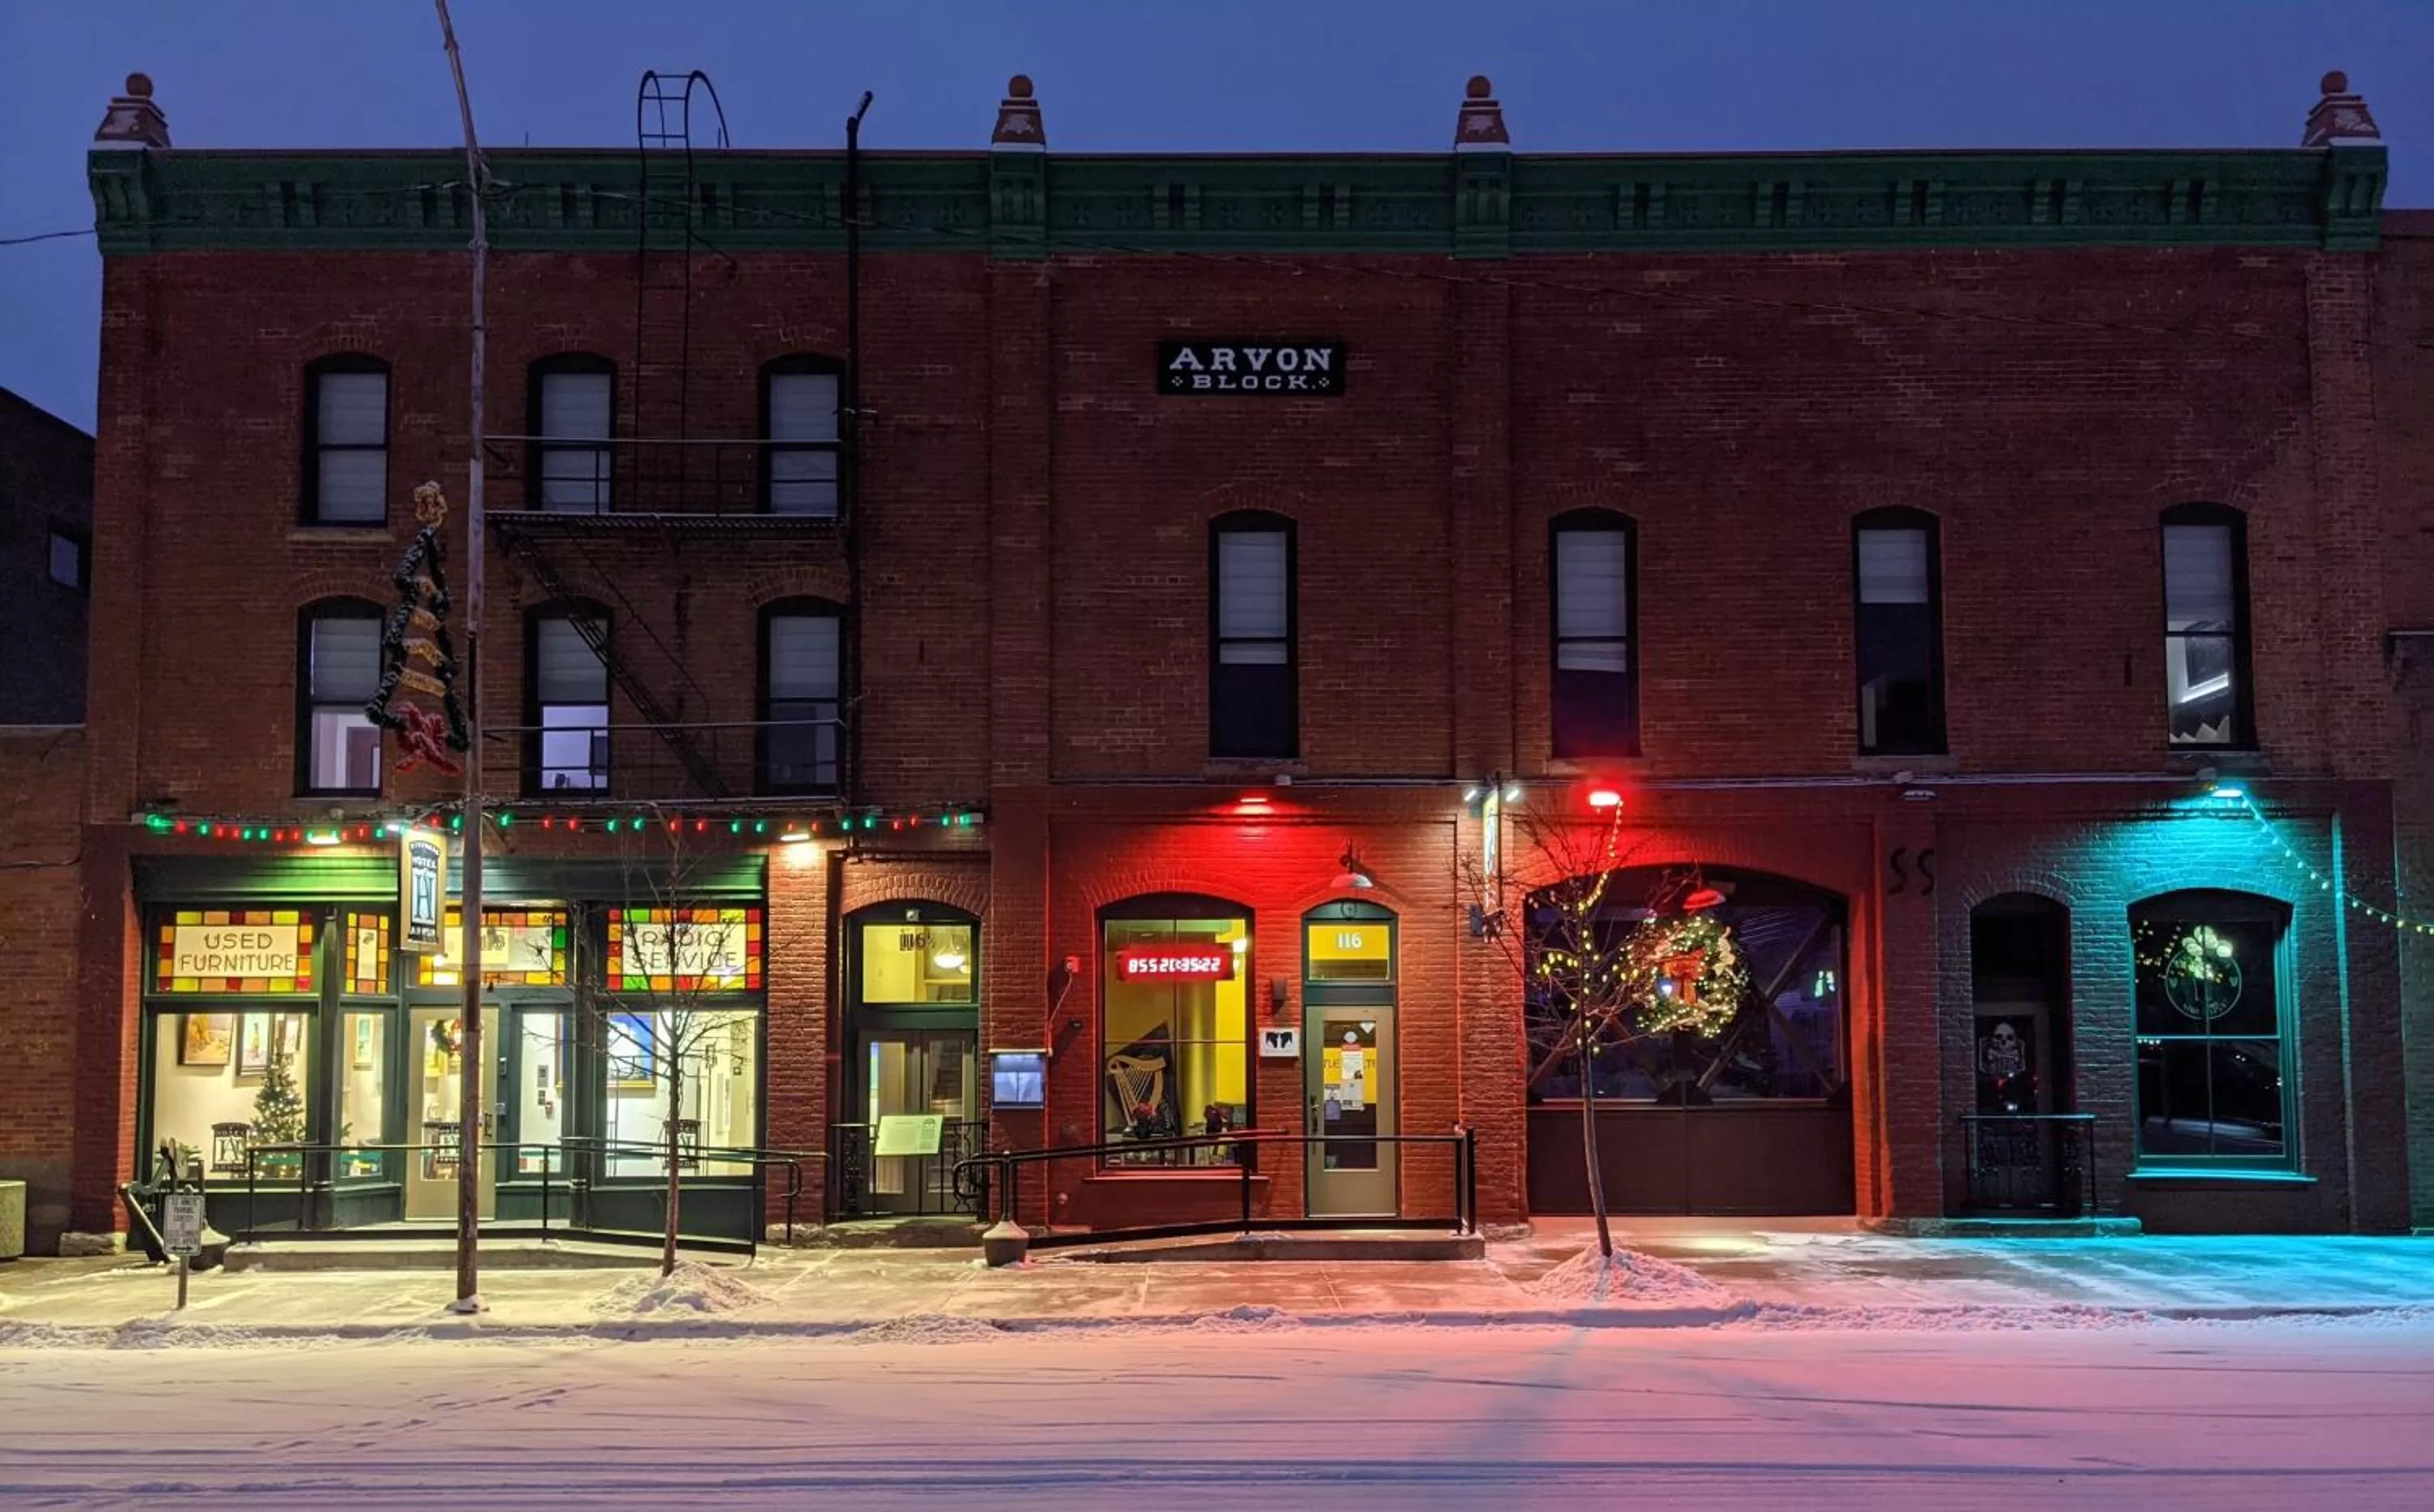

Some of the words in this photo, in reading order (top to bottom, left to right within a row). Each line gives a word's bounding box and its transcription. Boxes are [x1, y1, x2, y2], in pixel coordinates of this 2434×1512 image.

[1169, 347, 1332, 371] ARVON
[204, 933, 273, 950] USED
[1337, 934, 1362, 948] 116
[180, 953, 293, 972] FURNITURE
